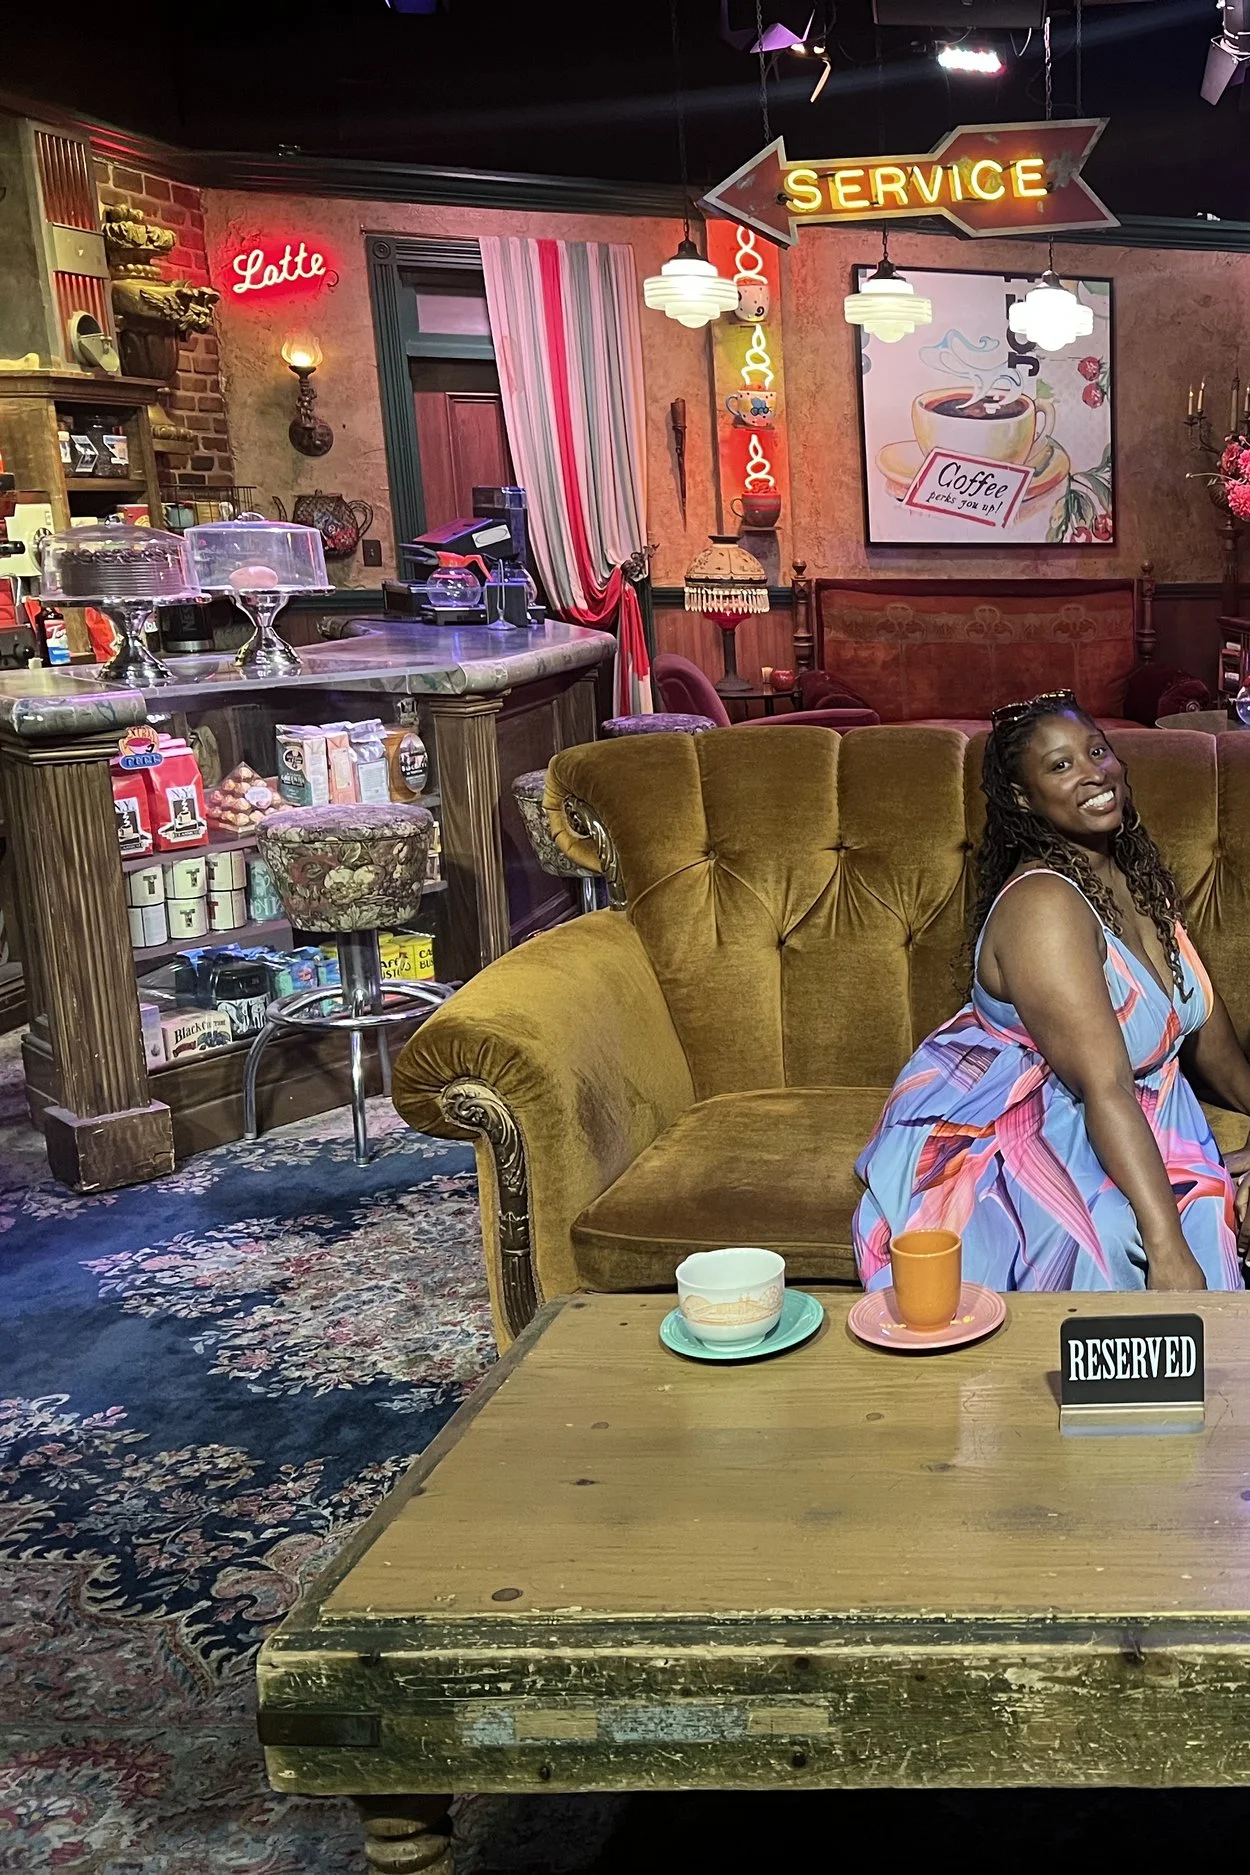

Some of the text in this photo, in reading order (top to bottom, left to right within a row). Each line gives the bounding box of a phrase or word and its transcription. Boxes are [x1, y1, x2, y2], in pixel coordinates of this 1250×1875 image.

[783, 158, 1047, 212] SERVICE
[233, 242, 326, 293] Latte
[938, 461, 1009, 499] Coffee
[926, 491, 1003, 516] perks you up!
[143, 874, 157, 895] T
[186, 867, 200, 887] T
[180, 908, 196, 928] T
[174, 1021, 202, 1045] Black
[1068, 1335, 1197, 1381] RESERVED
